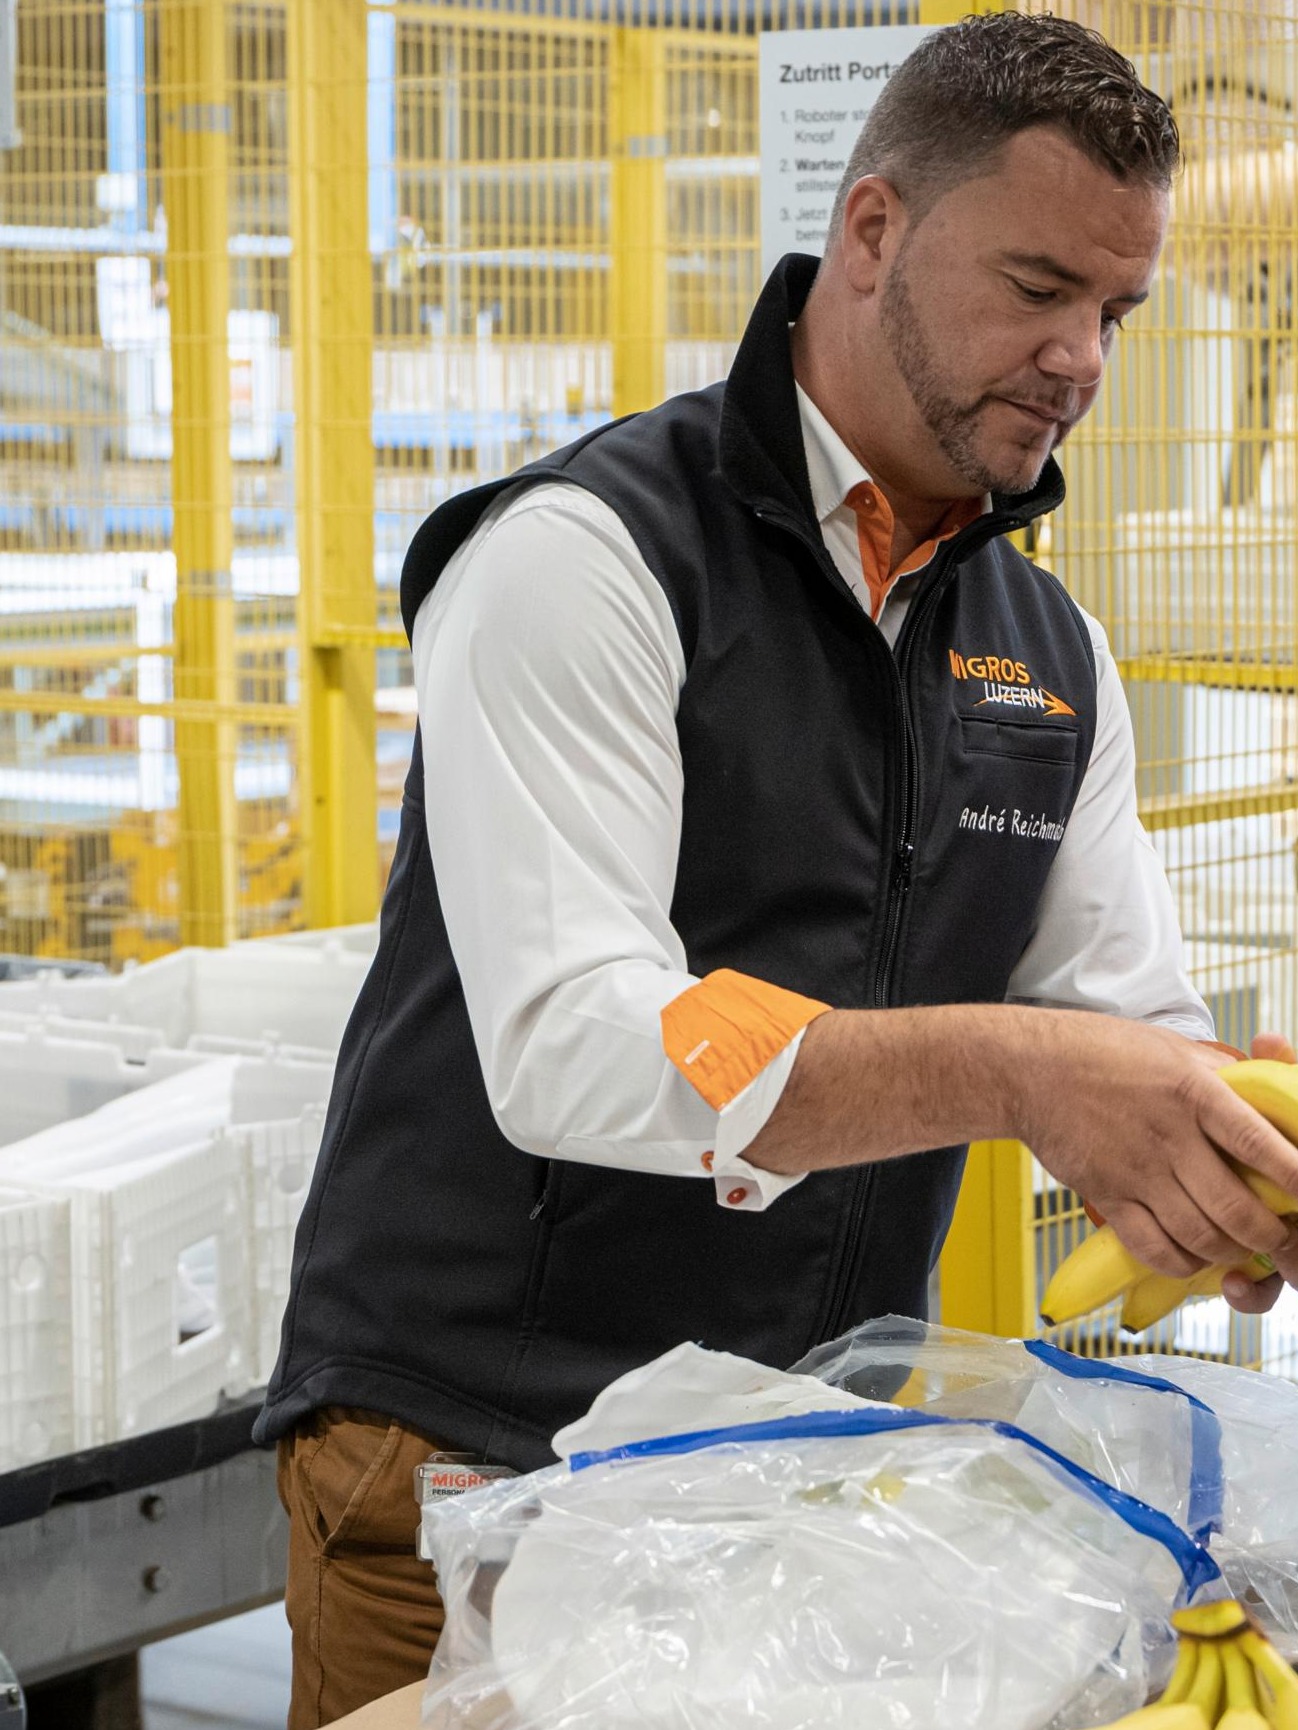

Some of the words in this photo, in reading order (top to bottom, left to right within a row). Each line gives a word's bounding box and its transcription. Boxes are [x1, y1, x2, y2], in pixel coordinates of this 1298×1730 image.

[779, 64, 841, 83] Zutritt
[795, 109, 847, 122] Roboter
[795, 129, 834, 144] Knopf
[795, 158, 845, 171] Warten
[795, 208, 827, 220] Jetzt
[984, 681, 1045, 708] LUZERN
[959, 805, 1006, 833] André
